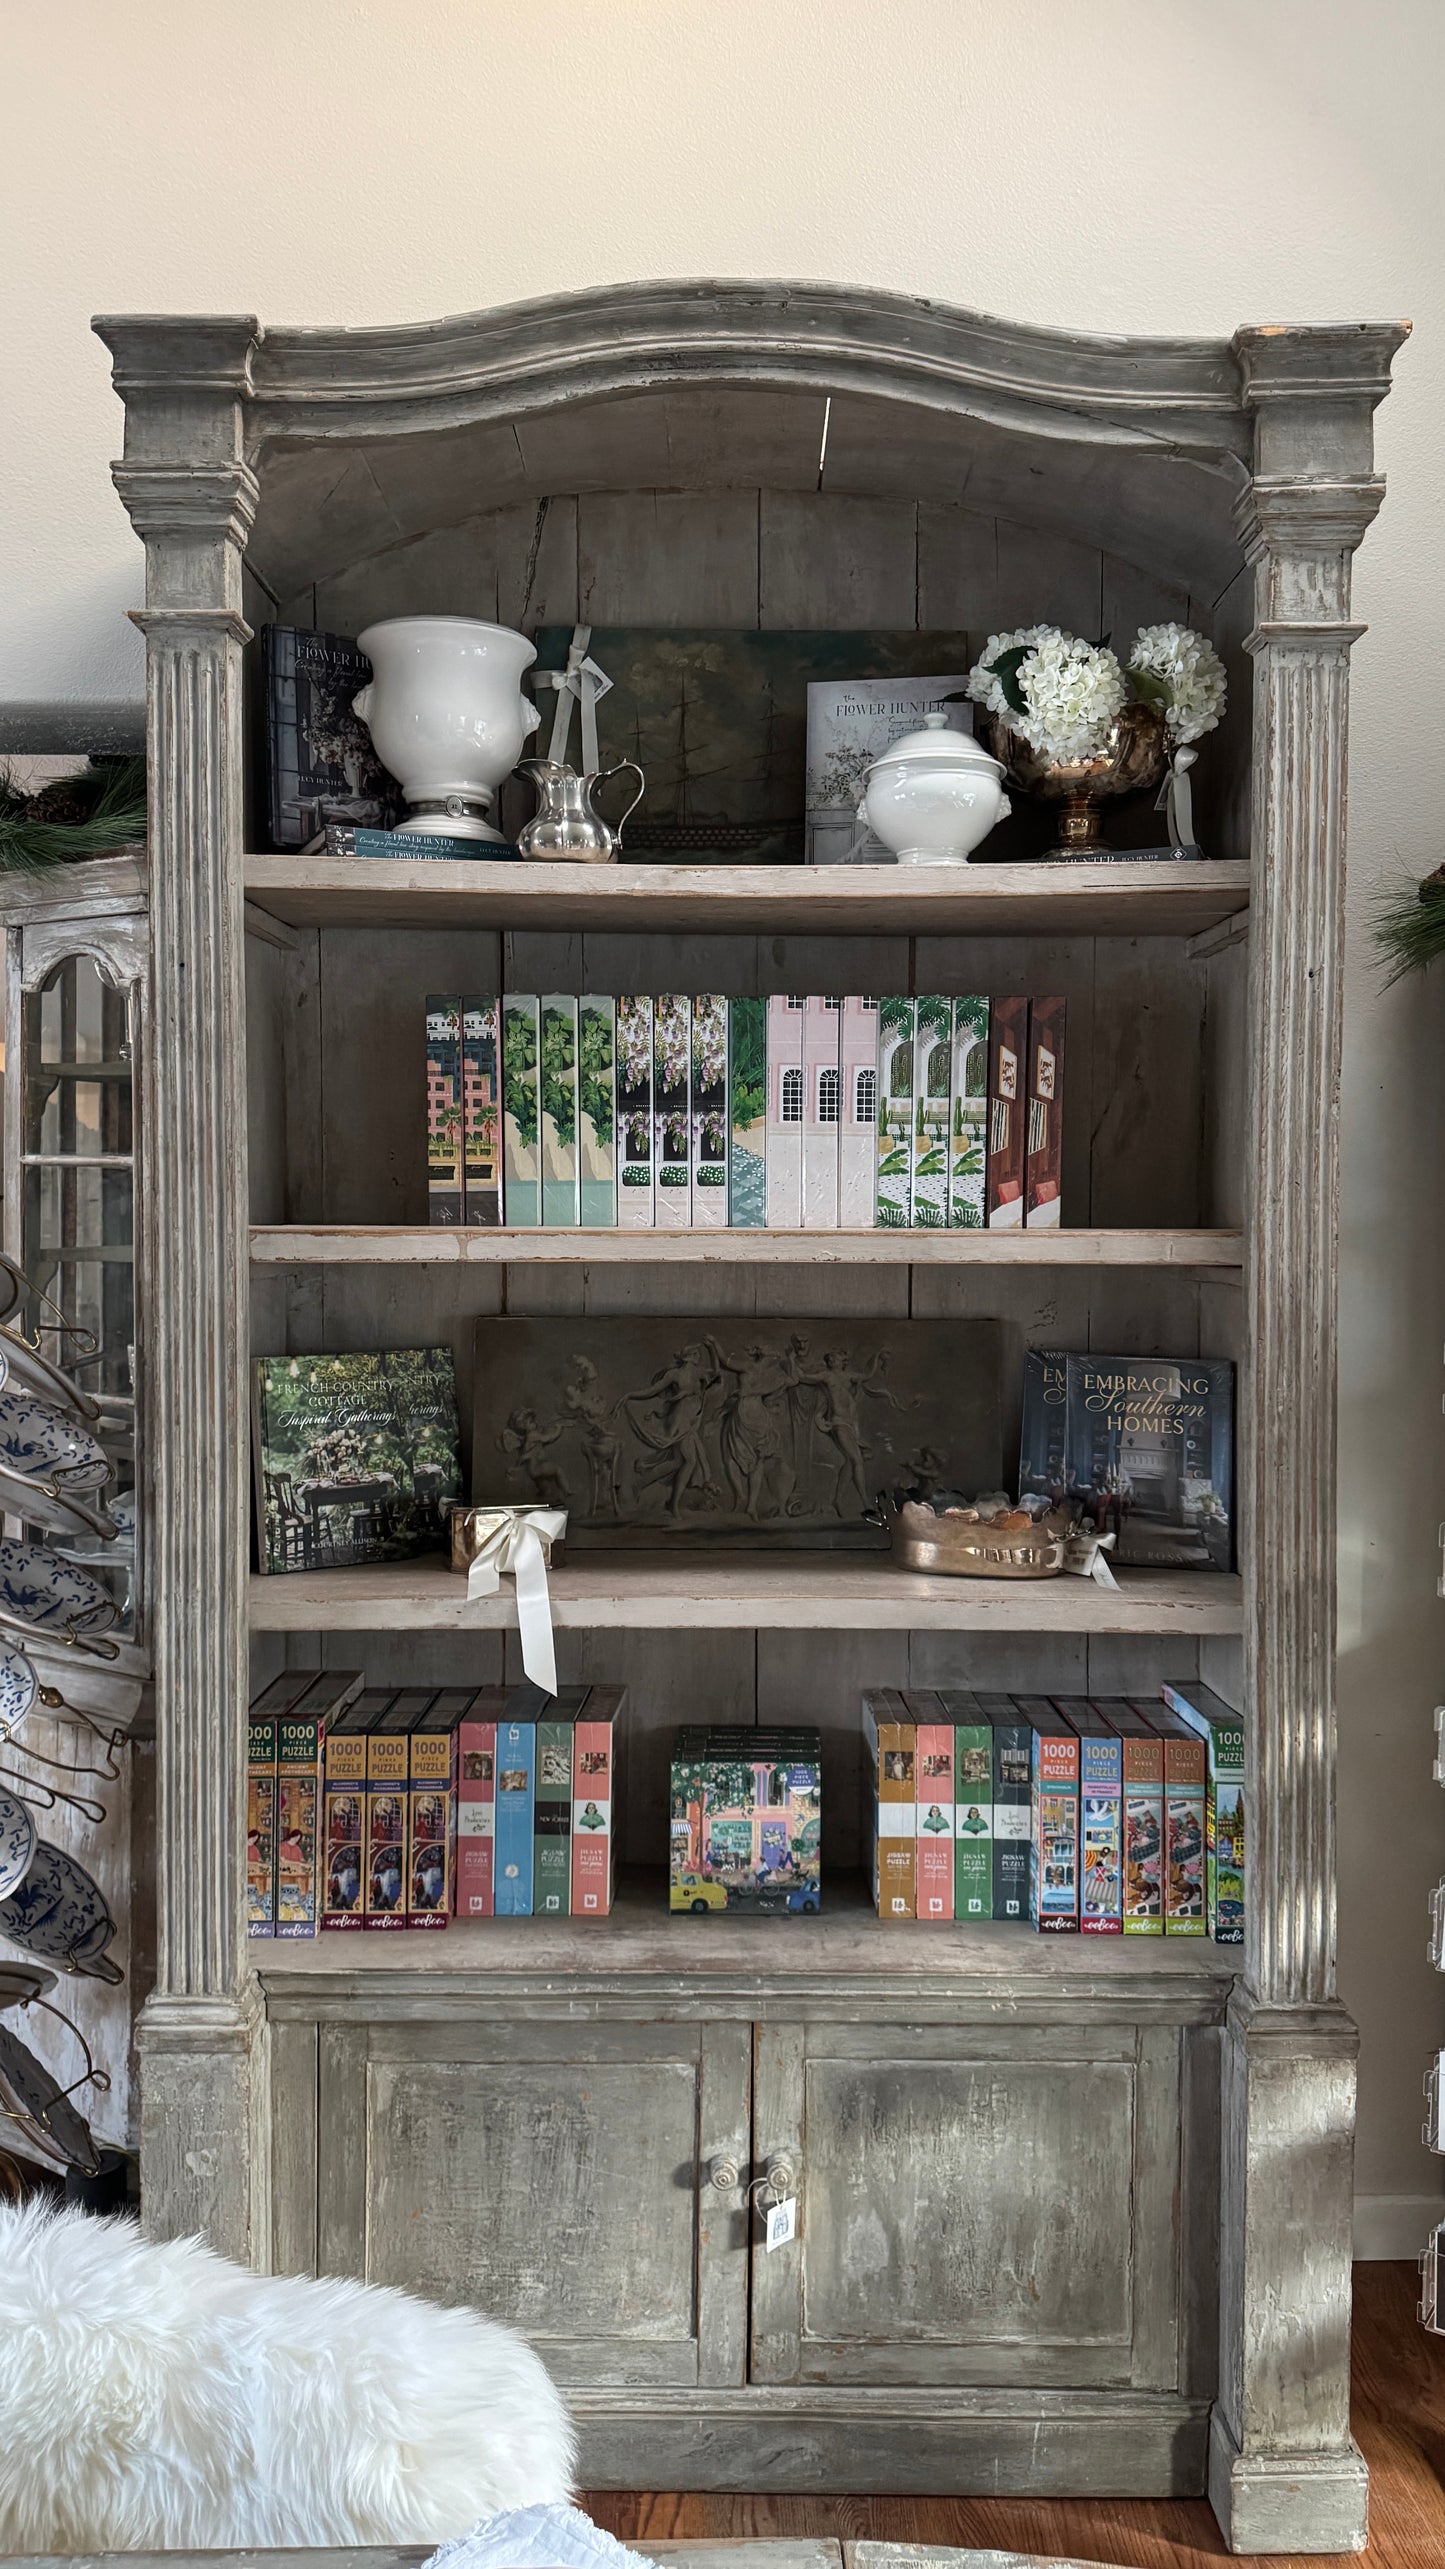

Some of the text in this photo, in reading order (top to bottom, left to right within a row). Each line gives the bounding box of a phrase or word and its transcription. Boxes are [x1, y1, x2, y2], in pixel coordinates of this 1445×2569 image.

[297, 645, 350, 666] FLOWER
[836, 701, 945, 717] FLOWER HUNTER
[393, 833, 422, 844] FLOWER
[424, 837, 454, 847] HUNTER
[278, 1379, 394, 1395] FRENCH COUNTRY
[1084, 1374, 1209, 1395] EMBRACING
[308, 1395, 367, 1408] COTTAGE
[1085, 1384, 1206, 1417] Southern
[278, 1408, 397, 1431] Inspired Gatherings
[1107, 1415, 1185, 1435] HOMES
[248, 1726, 272, 1740] 000
[281, 1725, 315, 1739] 1000
[1218, 1732, 1244, 1745] 100
[248, 1746, 272, 1757] ZZLE
[281, 1746, 314, 1757] PUZZLE
[330, 1743, 362, 1756] 1000
[371, 1743, 404, 1756] 1000
[414, 1742, 446, 1755] 1000
[1042, 1743, 1076, 1758] 1000
[1086, 1746, 1118, 1760] 1000
[1128, 1747, 1160, 1760] 1000
[1170, 1748, 1200, 1761] 1000
[1218, 1752, 1244, 1762] PUZZL
[330, 1763, 362, 1773] PUZZLE
[371, 1763, 403, 1774] PUZZLE
[414, 1762, 446, 1772] PUZZLE
[1043, 1765, 1075, 1776] PUZZLE
[1086, 1766, 1118, 1777] PUZZLE
